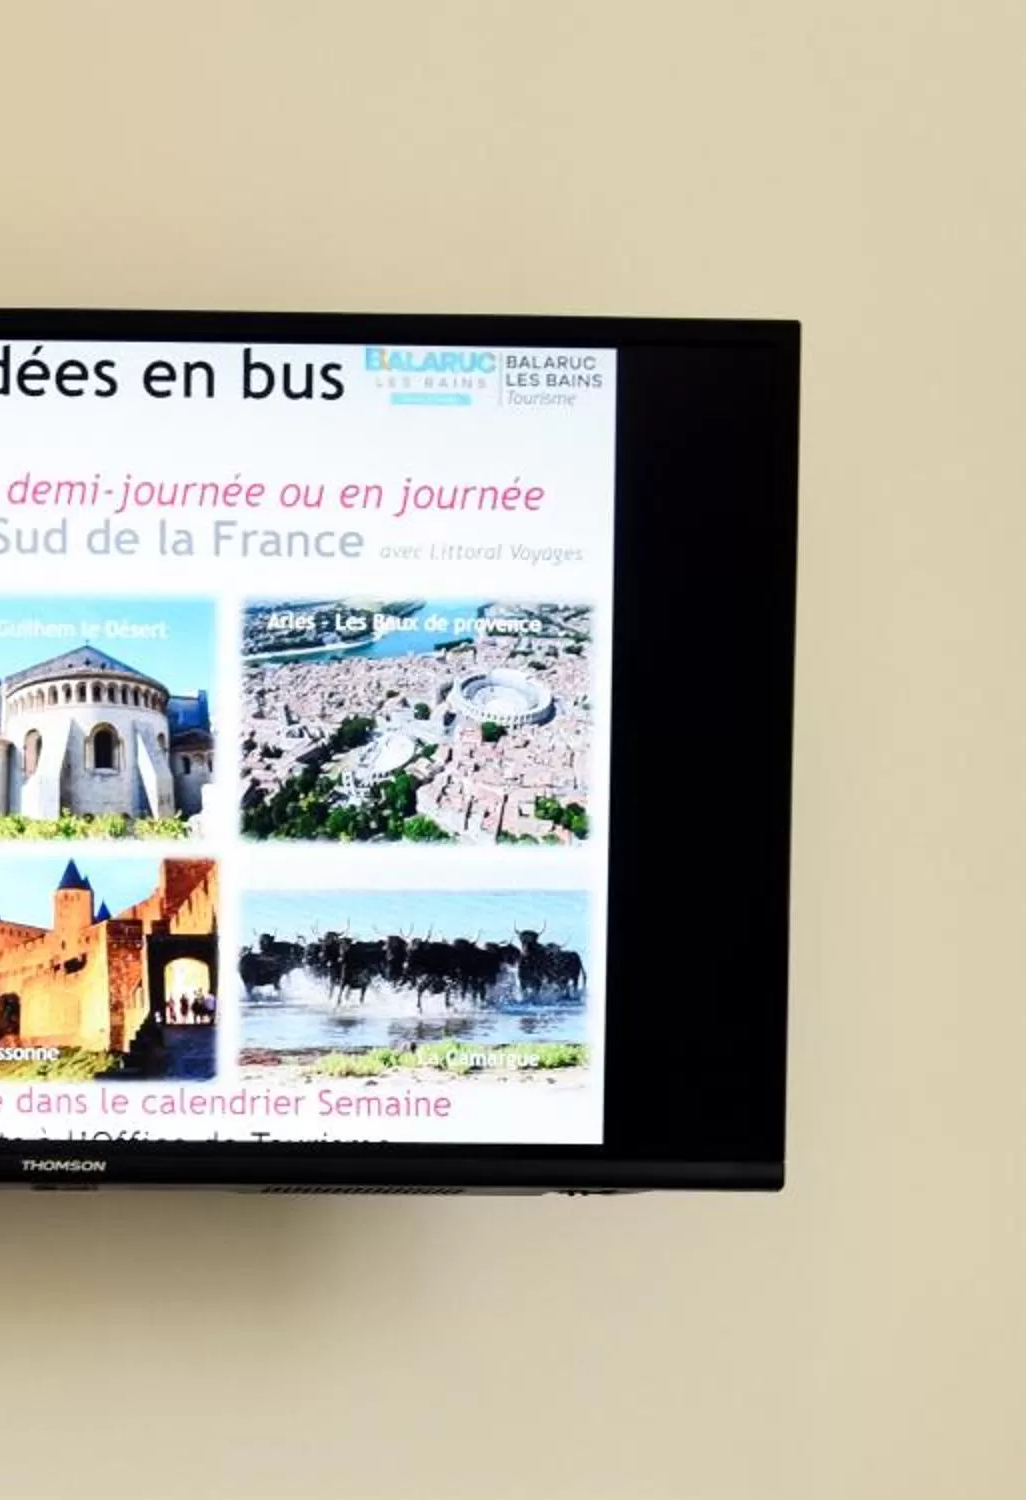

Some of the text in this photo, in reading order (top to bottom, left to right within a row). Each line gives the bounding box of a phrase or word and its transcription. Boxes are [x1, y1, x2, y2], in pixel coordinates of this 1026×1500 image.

[365, 348, 496, 374] BALARUC
[505, 355, 597, 371] BALARUC
[142, 359, 215, 399] en
[243, 348, 345, 401] bus
[376, 377, 488, 390] LES BAINS
[505, 373, 604, 389] LES BAINS
[507, 389, 577, 407] Tourisme
[6, 471, 266, 514] demi-journée
[279, 482, 324, 509] ou
[340, 483, 383, 510] en
[393, 476, 545, 517] journée
[86, 519, 140, 557] de
[158, 519, 194, 557] la
[213, 521, 365, 559] France
[379, 542, 584, 566] avec Littoral Voyages
[266, 613, 315, 631] Arles
[335, 614, 367, 632] Les
[423, 614, 448, 632] de
[453, 617, 543, 636] provence
[16, 1086, 87, 1115] dans
[102, 1087, 129, 1115] le
[141, 1087, 305, 1117] calendrier
[318, 1089, 452, 1118] Semaine
[22, 1159, 107, 1172] THOMSON
